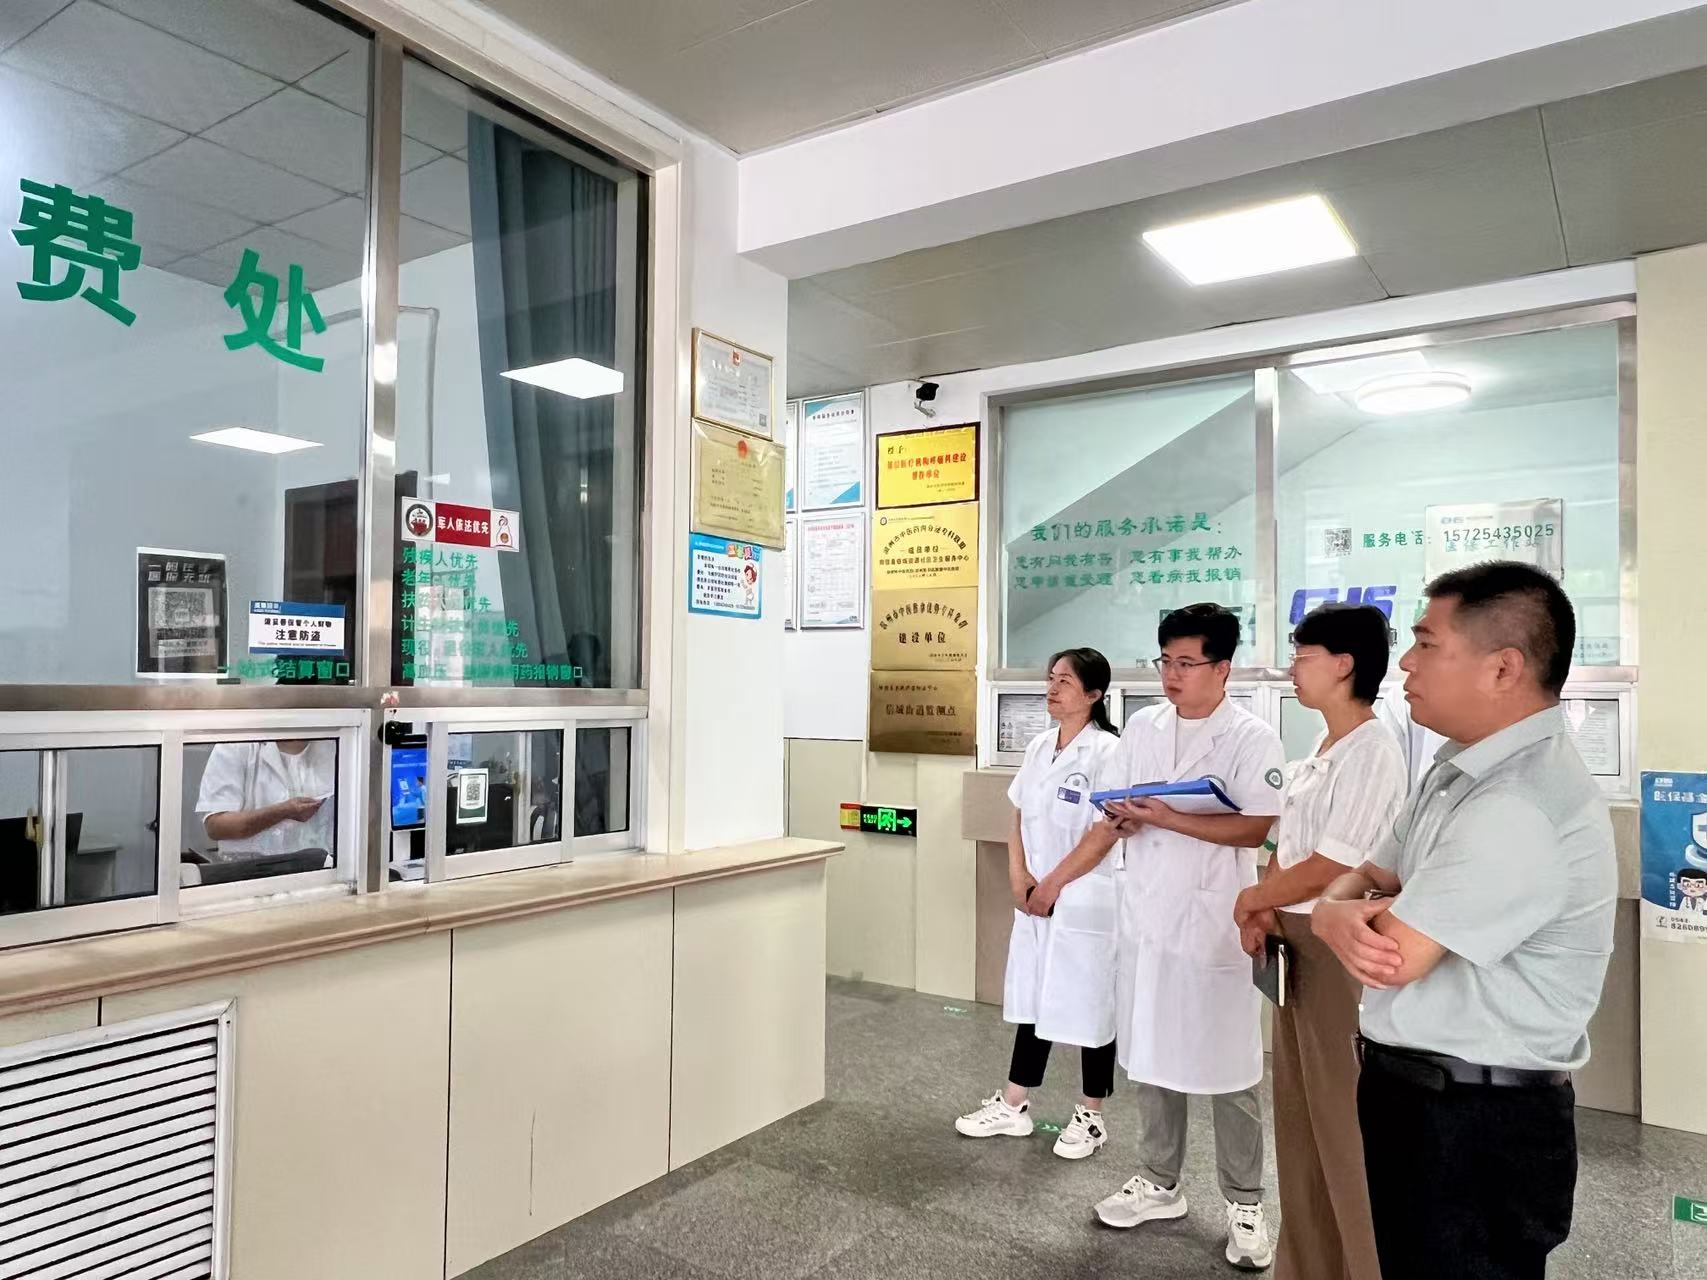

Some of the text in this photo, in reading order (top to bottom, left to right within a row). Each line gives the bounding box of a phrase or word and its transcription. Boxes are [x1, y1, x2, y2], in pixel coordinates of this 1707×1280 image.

[437, 516, 490, 535] 军人依法优先
[1032, 512, 1223, 542] 我们的服务承诺是:
[1363, 523, 1555, 548] 服务电话: 15725435025
[275, 628, 321, 642] 注意防盗
